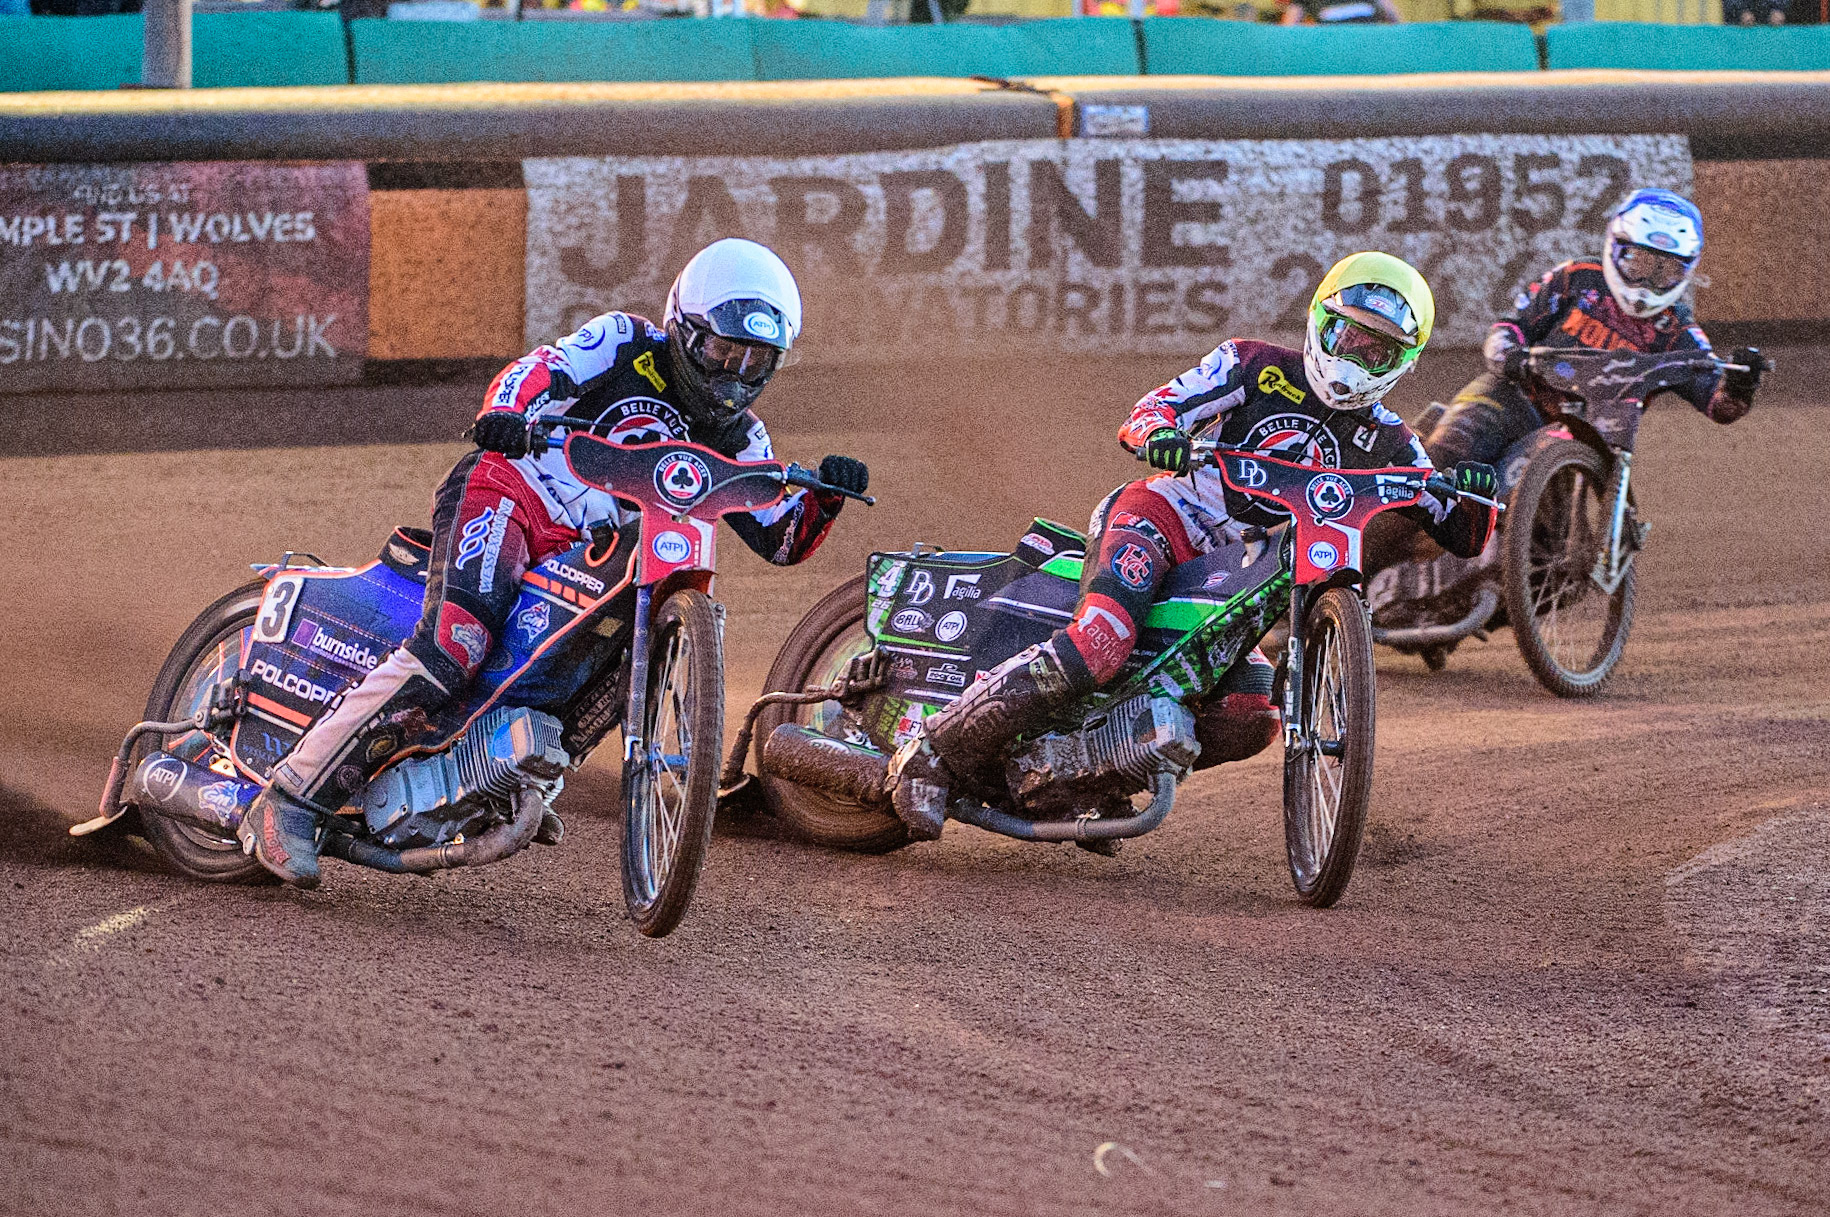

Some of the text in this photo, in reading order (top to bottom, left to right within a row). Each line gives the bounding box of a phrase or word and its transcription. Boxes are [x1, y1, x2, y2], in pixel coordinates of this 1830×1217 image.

[96, 212, 138, 244] ST
[170, 212, 316, 244] WOLVES
[558, 158, 1231, 290] JARDINE
[47, 259, 220, 300] WV2 4AQ
[620, 401, 684, 436] BELLE VUE
[1258, 418, 1300, 438] BELLE
[659, 454, 677, 473] BELLE
[660, 541, 684, 552] ATPI
[1312, 549, 1333, 560] ATPI
[260, 581, 297, 638] 3
[312, 626, 379, 671] burnside
[250, 658, 338, 706] POLCOPP
[148, 766, 179, 787] ATPI
